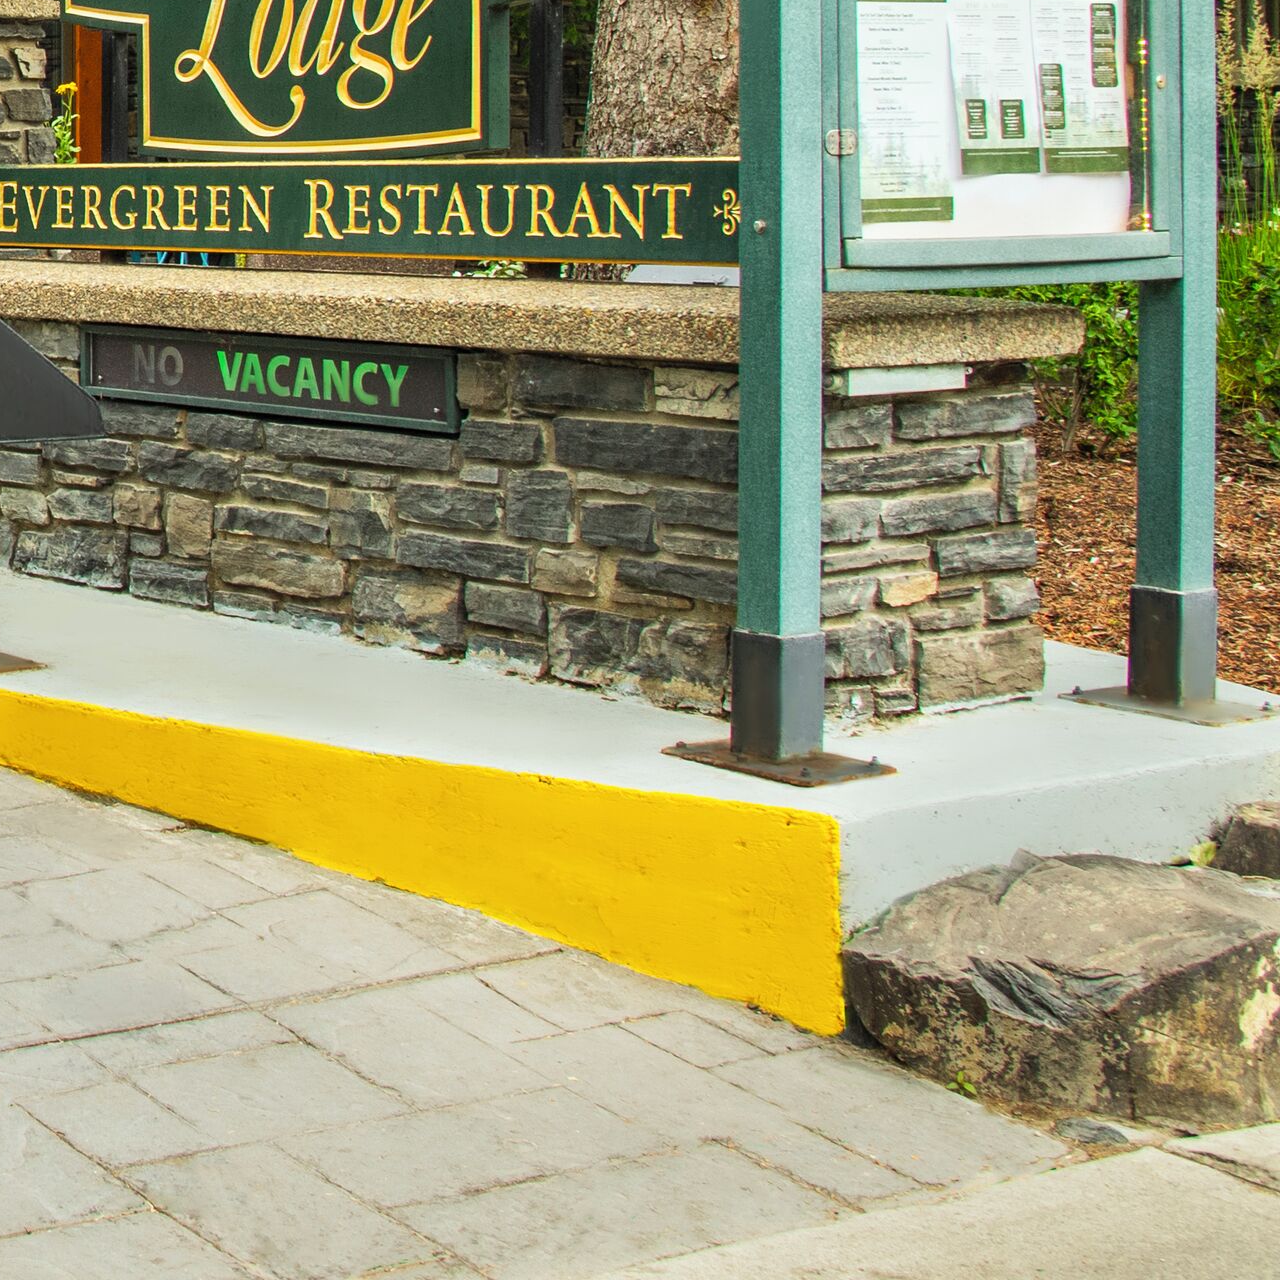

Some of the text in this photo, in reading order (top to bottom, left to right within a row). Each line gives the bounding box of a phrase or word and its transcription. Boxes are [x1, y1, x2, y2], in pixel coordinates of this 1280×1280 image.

[303, 177, 692, 241] RESTAURANT
[131, 343, 409, 408] NO VACANCY
